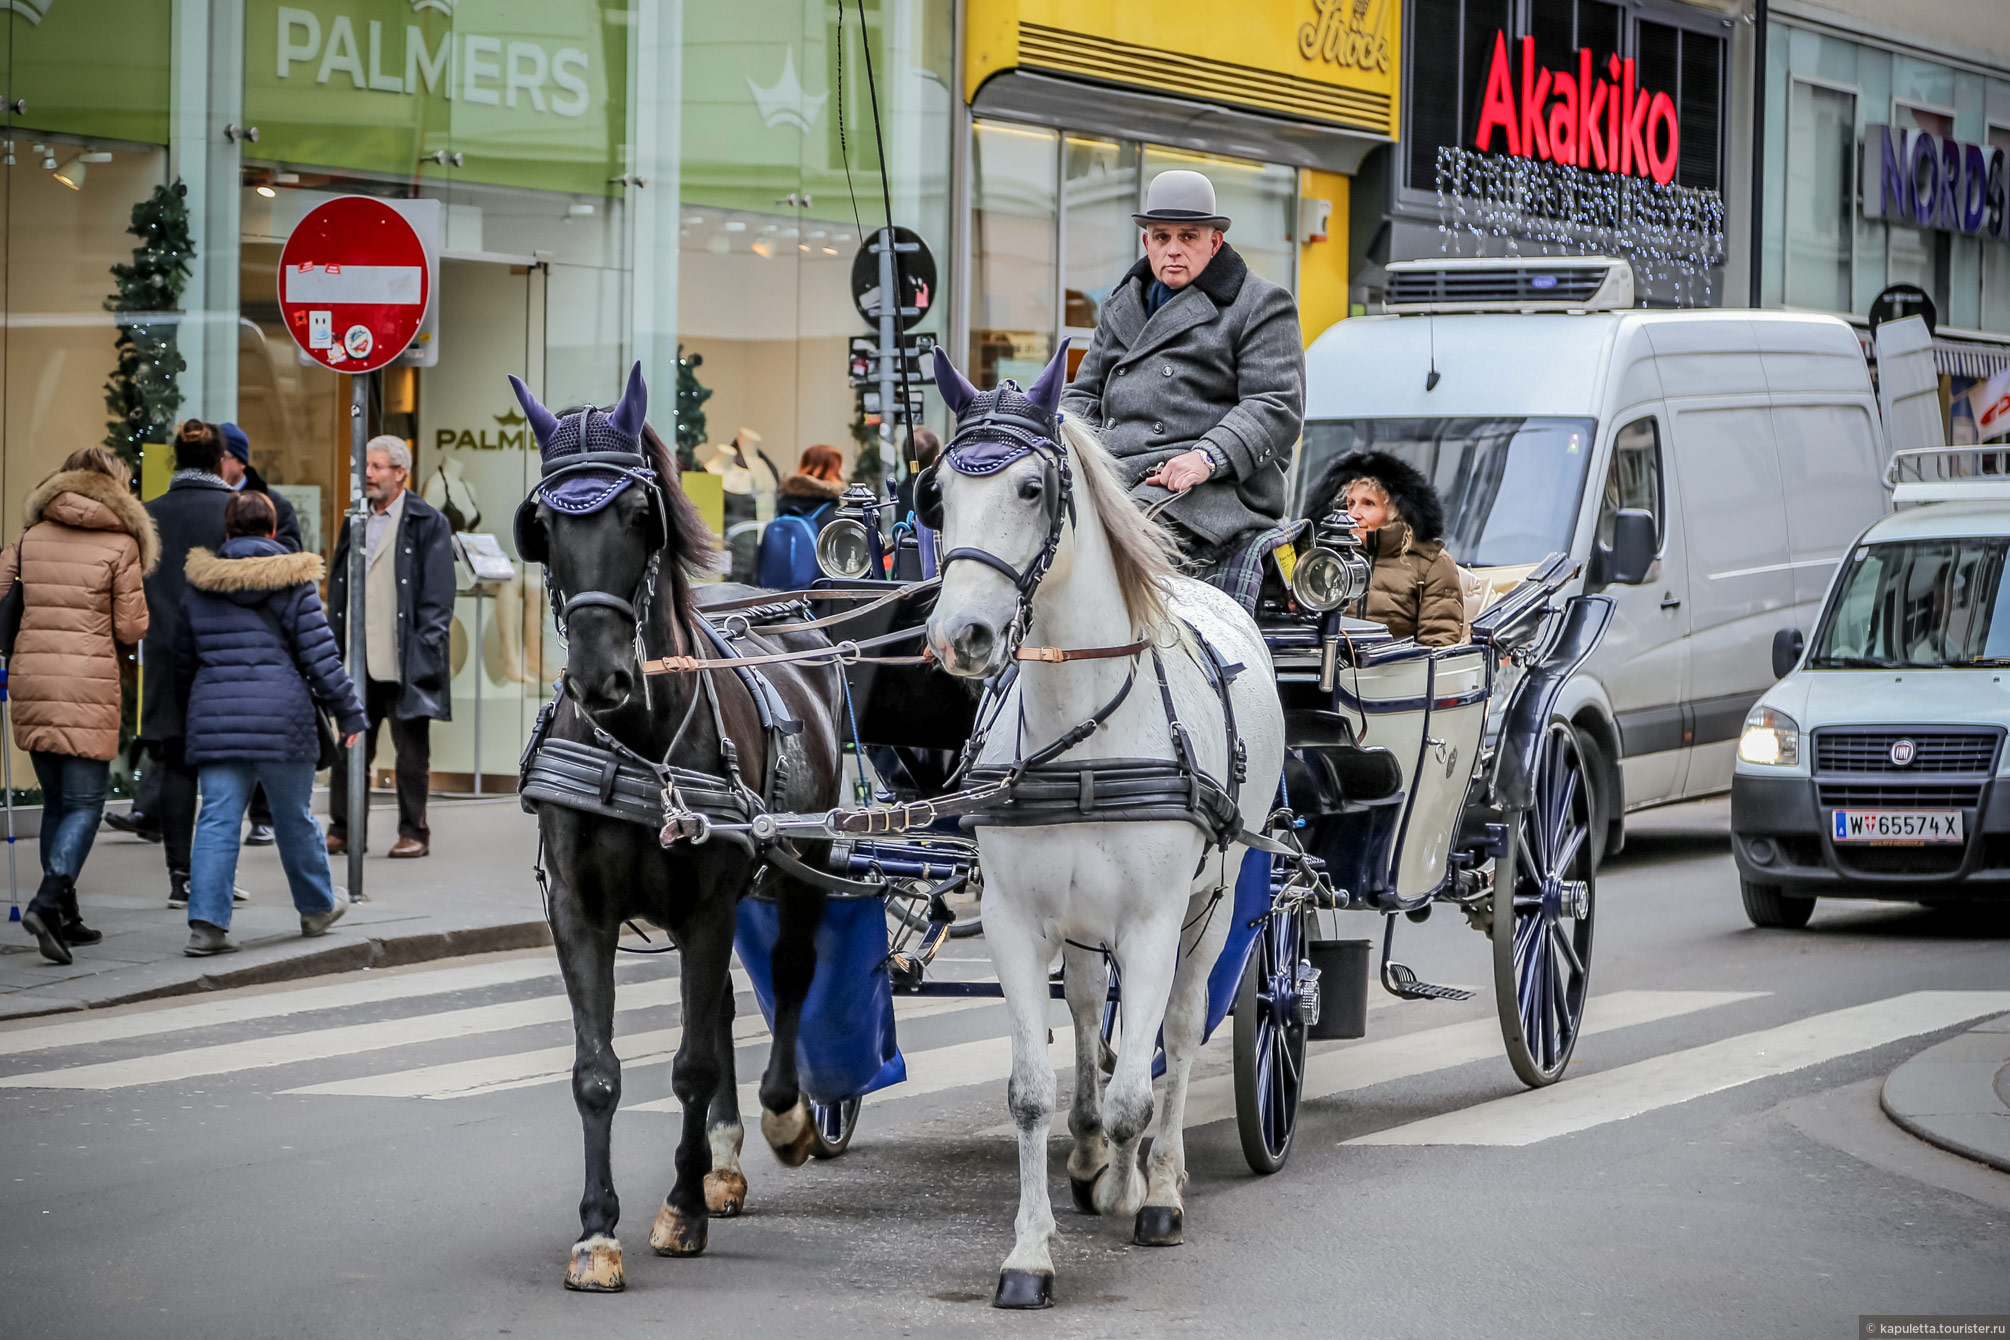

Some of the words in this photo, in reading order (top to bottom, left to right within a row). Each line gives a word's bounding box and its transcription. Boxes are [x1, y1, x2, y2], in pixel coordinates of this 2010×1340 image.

[276, 7, 590, 118] PALMERS
[1476, 28, 1680, 185] Akakiko
[1879, 123, 2010, 239] NORDS
[1850, 816, 1863, 835] W
[1879, 816, 1939, 835] 65574
[1945, 816, 1956, 835] X
